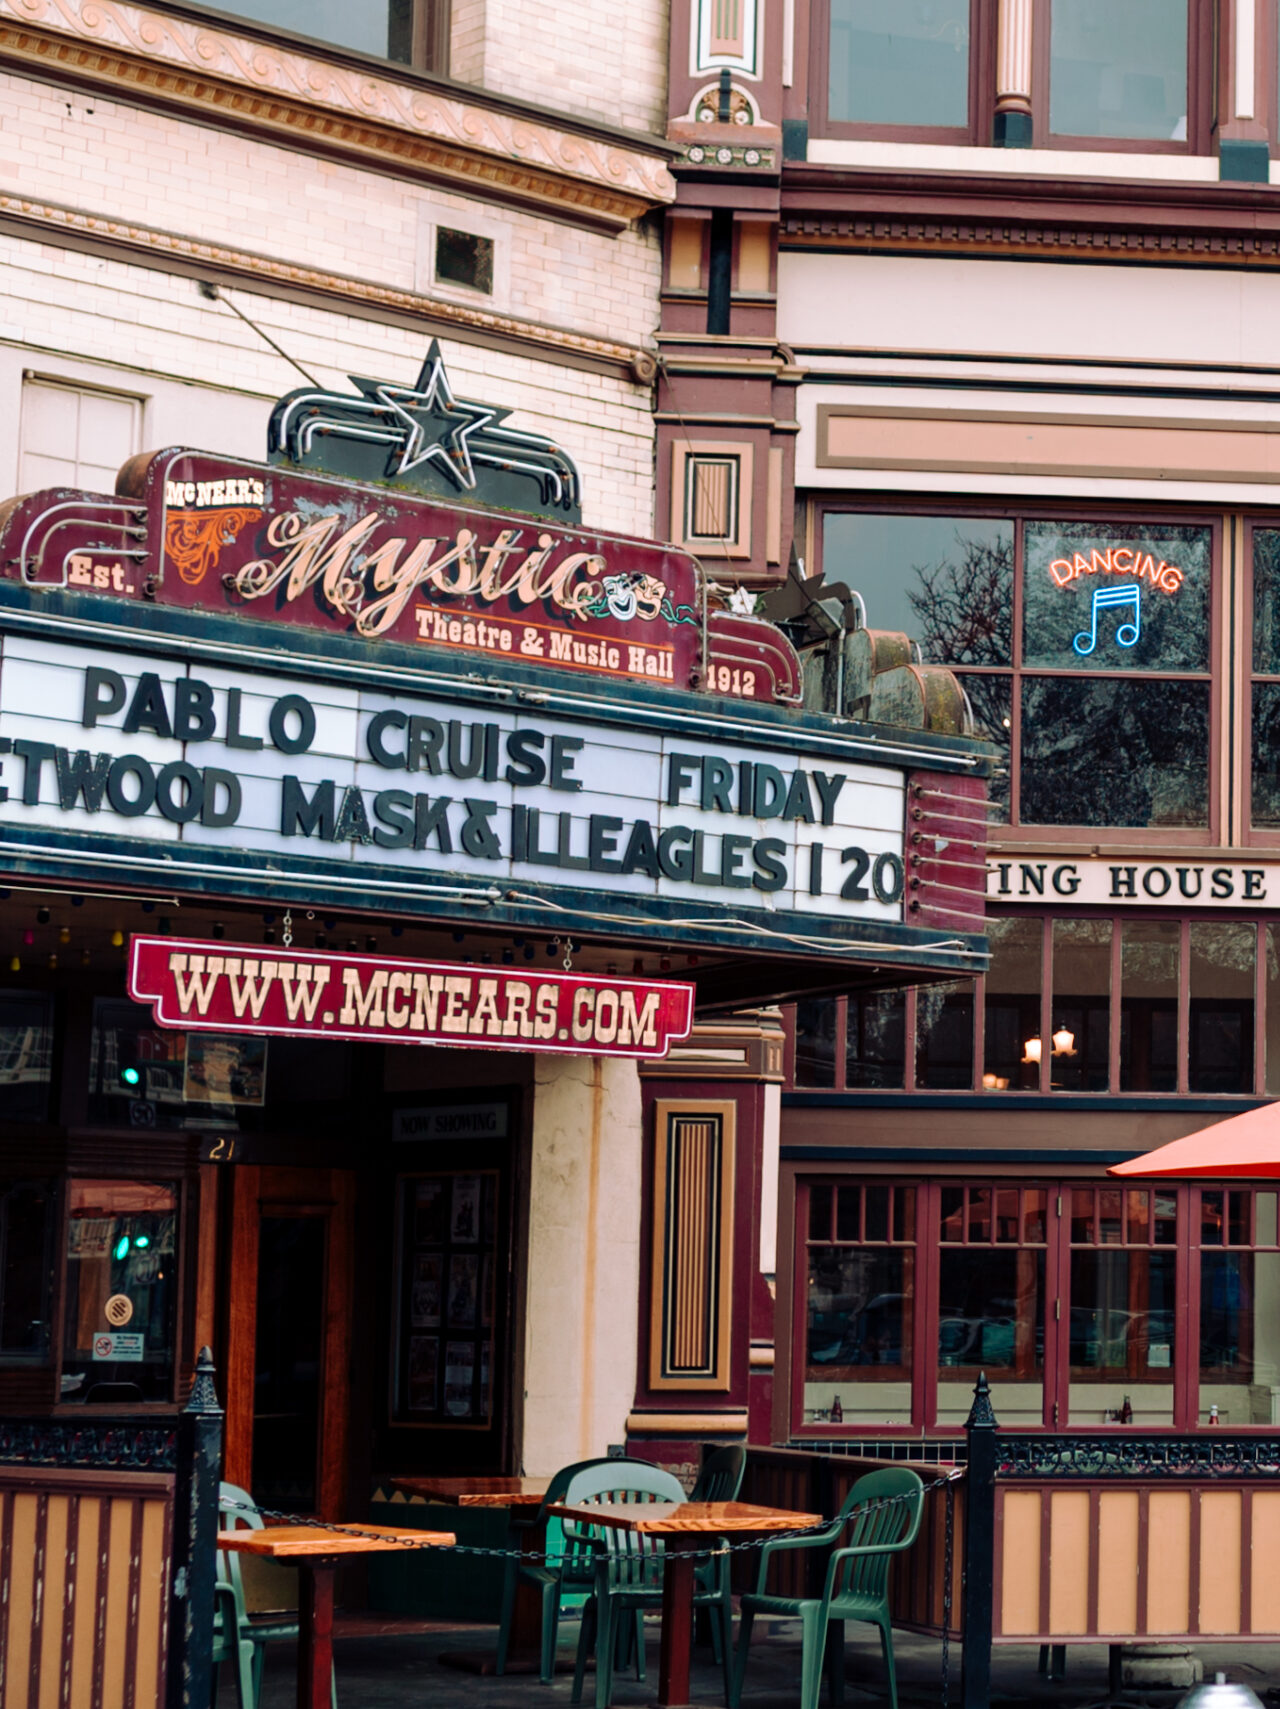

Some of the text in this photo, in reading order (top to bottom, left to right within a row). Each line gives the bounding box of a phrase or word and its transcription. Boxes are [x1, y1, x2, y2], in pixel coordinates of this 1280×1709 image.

[68, 555, 135, 594] Est.
[236, 511, 606, 637] Mystic
[1050, 547, 1184, 592] DANCING
[415, 608, 674, 679] Theatre & Music Hall
[707, 664, 757, 696] 1912
[82, 665, 847, 827] PABLO CRUISE FRIDAY
[985, 862, 1082, 896] ING
[1108, 865, 1267, 901] HOUSE
[169, 952, 661, 1048] WWW.MCNEARS.COM
[400, 1111, 497, 1134] NOW SHOWING
[209, 1137, 235, 1160] 21
